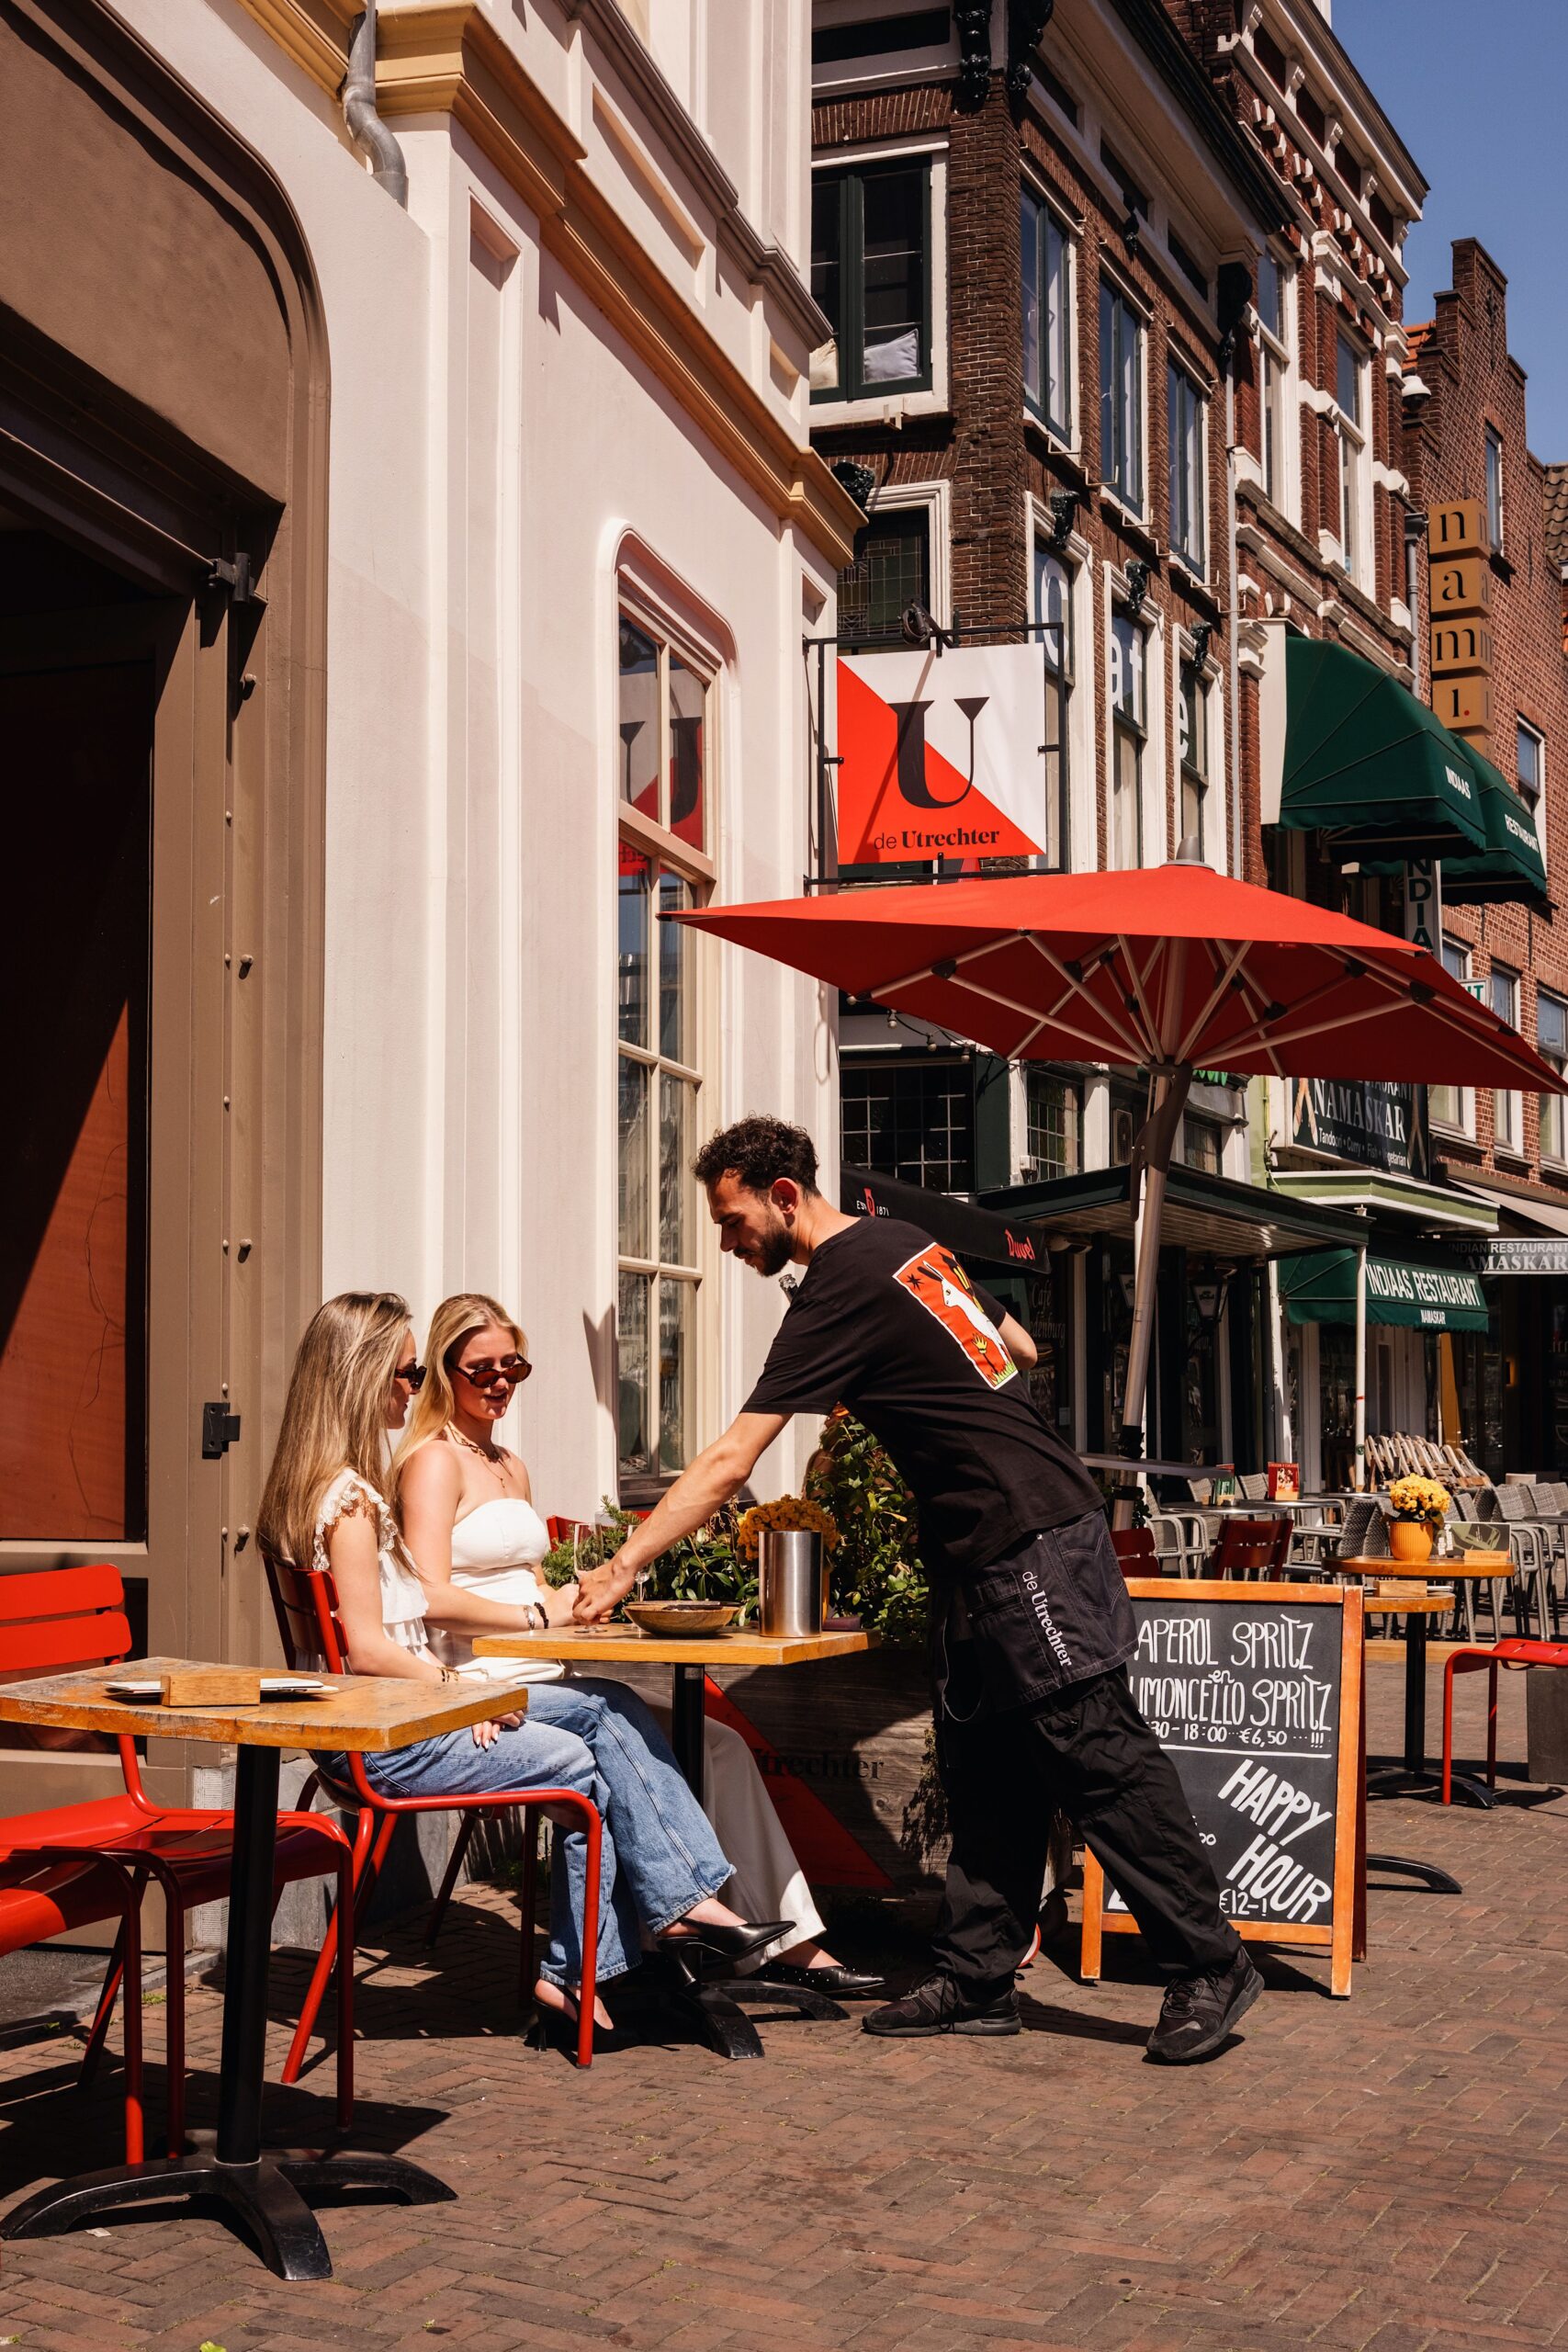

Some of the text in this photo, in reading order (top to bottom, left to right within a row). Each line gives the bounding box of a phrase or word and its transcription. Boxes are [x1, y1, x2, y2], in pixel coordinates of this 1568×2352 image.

[886, 695, 990, 809] U
[1445, 765, 1472, 800] INDIAAS
[874, 828, 1000, 850] de Utrechter
[1314, 1078, 1406, 1144] NAMASKAR
[1004, 1228, 1035, 1261] Duvel
[1465, 1255, 1568, 1271] AMASKAR
[1491, 1242, 1568, 1254] RESTAURANT
[1365, 1263, 1481, 1306] INDIAAS RESTAURANT
[1420, 1309, 1446, 1325] NAMASKAR
[1021, 1571, 1072, 1667] de Utrechter
[1134, 1612, 1314, 1670] APEROL SPRITZ
[1208, 1668, 1235, 1684] en
[1250, 1674, 1332, 1732] SPRITZ
[1217, 1758, 1333, 1847] HAPPY
[1225, 1833, 1333, 1924] HOUR
